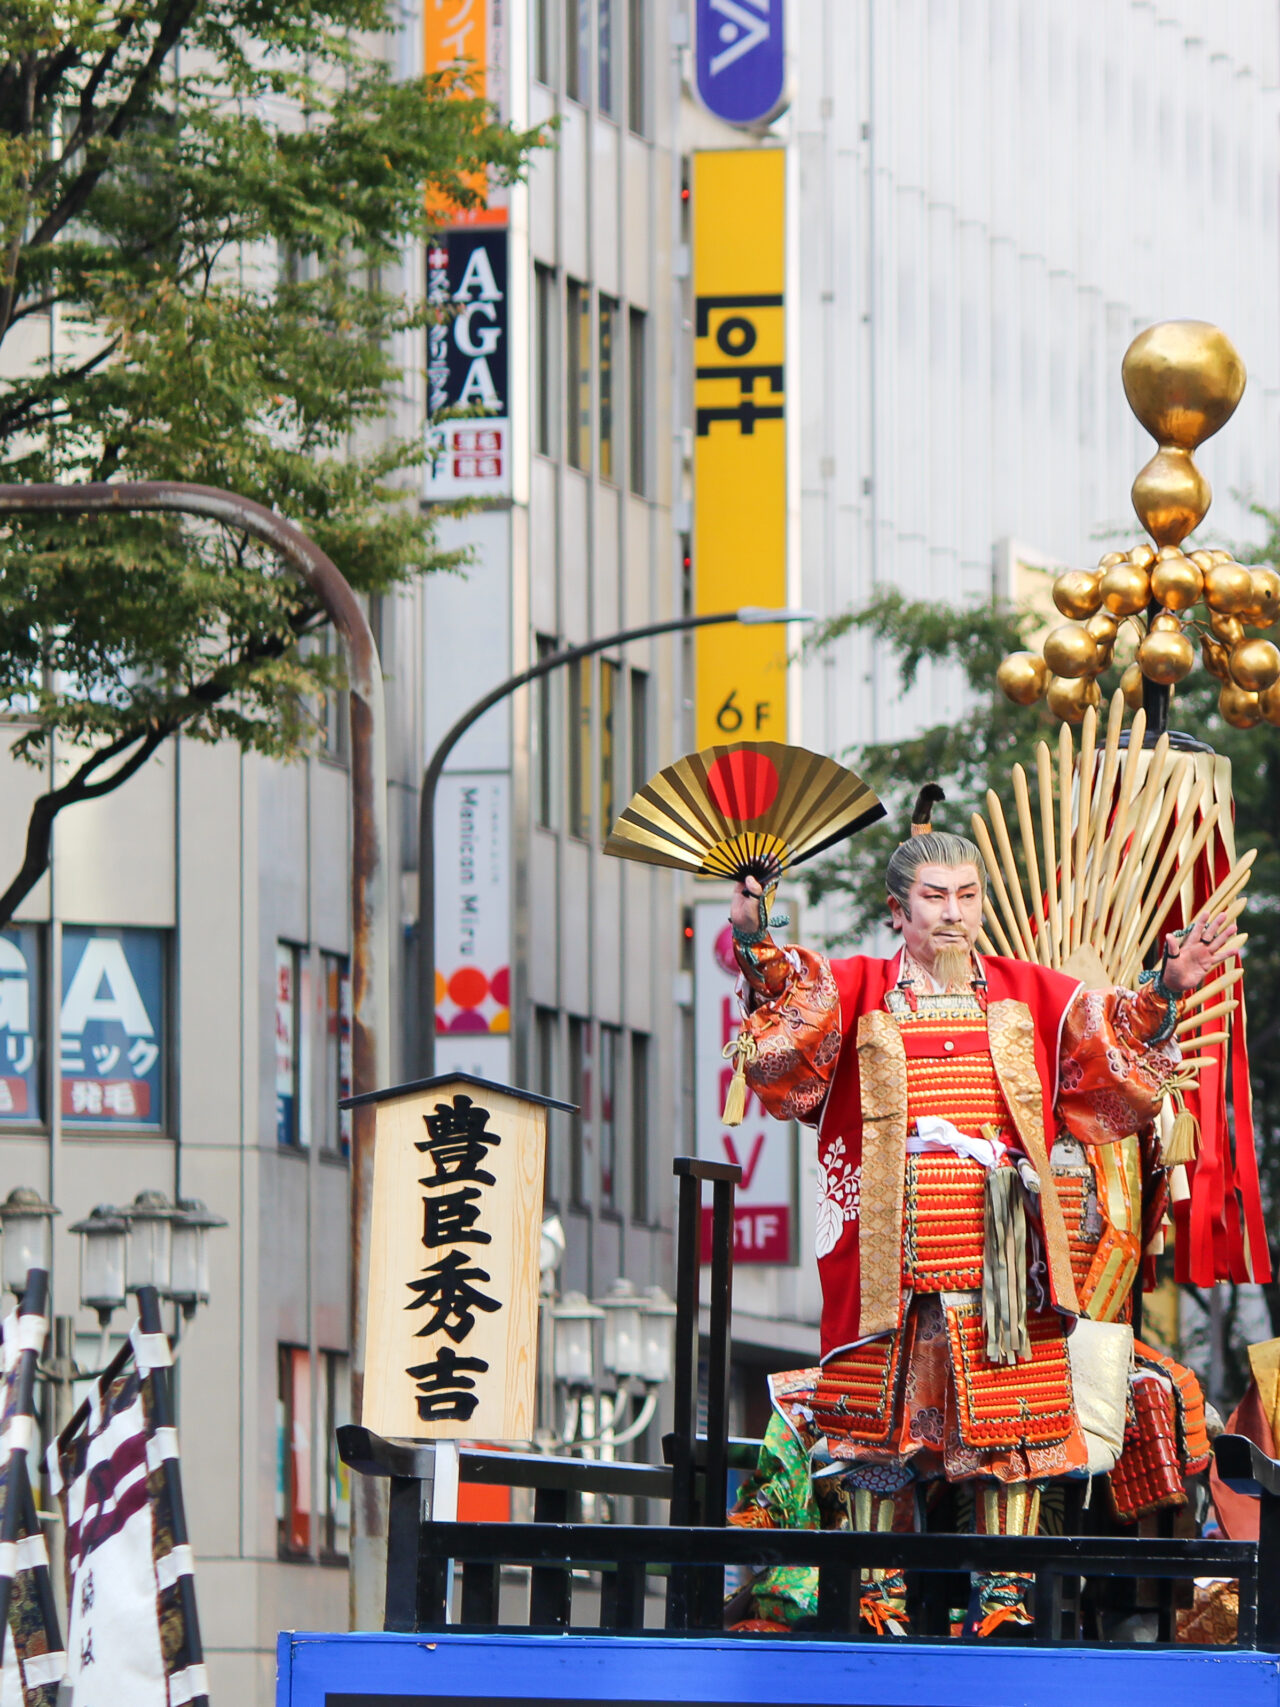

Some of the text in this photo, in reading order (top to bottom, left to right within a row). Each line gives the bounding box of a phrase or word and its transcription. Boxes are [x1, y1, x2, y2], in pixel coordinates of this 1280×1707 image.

[453, 246, 503, 411] AGA
[716, 688, 771, 732] 6F
[403, 1094, 503, 1423] 豊臣秀吉
